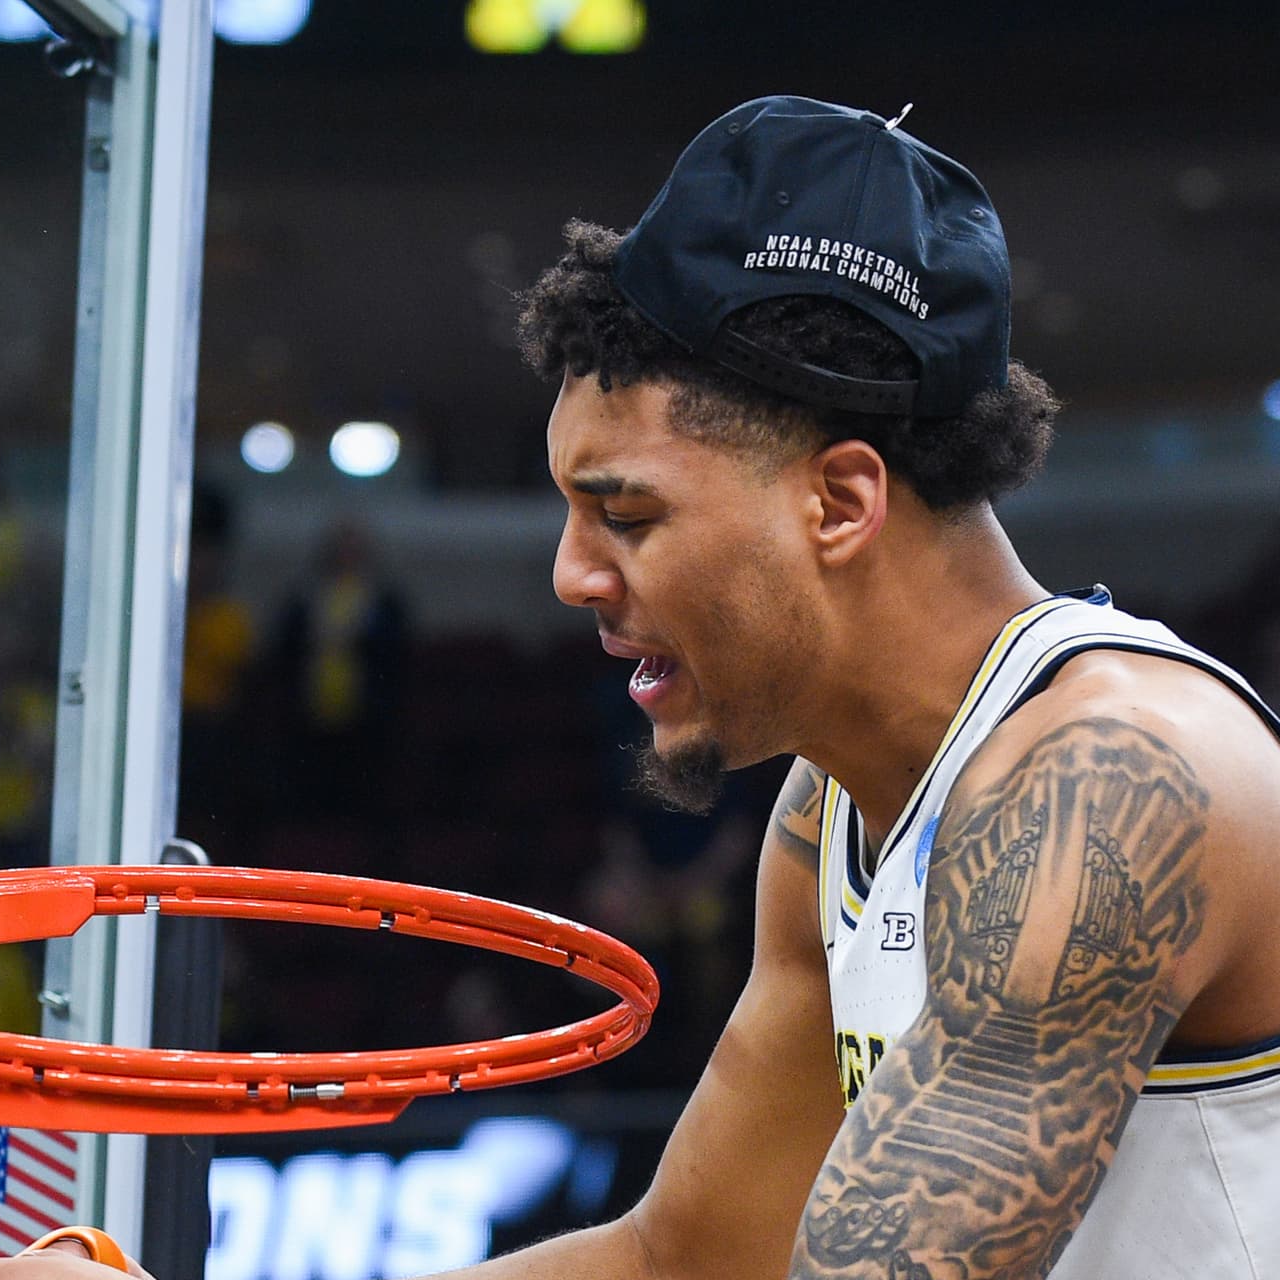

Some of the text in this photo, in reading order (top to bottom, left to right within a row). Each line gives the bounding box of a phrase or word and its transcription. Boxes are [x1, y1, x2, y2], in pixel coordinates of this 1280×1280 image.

[744, 251, 930, 320] REGIONAL CHAMPIONS
[766, 234, 920, 294] NCAA BASKETBALL
[880, 912, 916, 951] B
